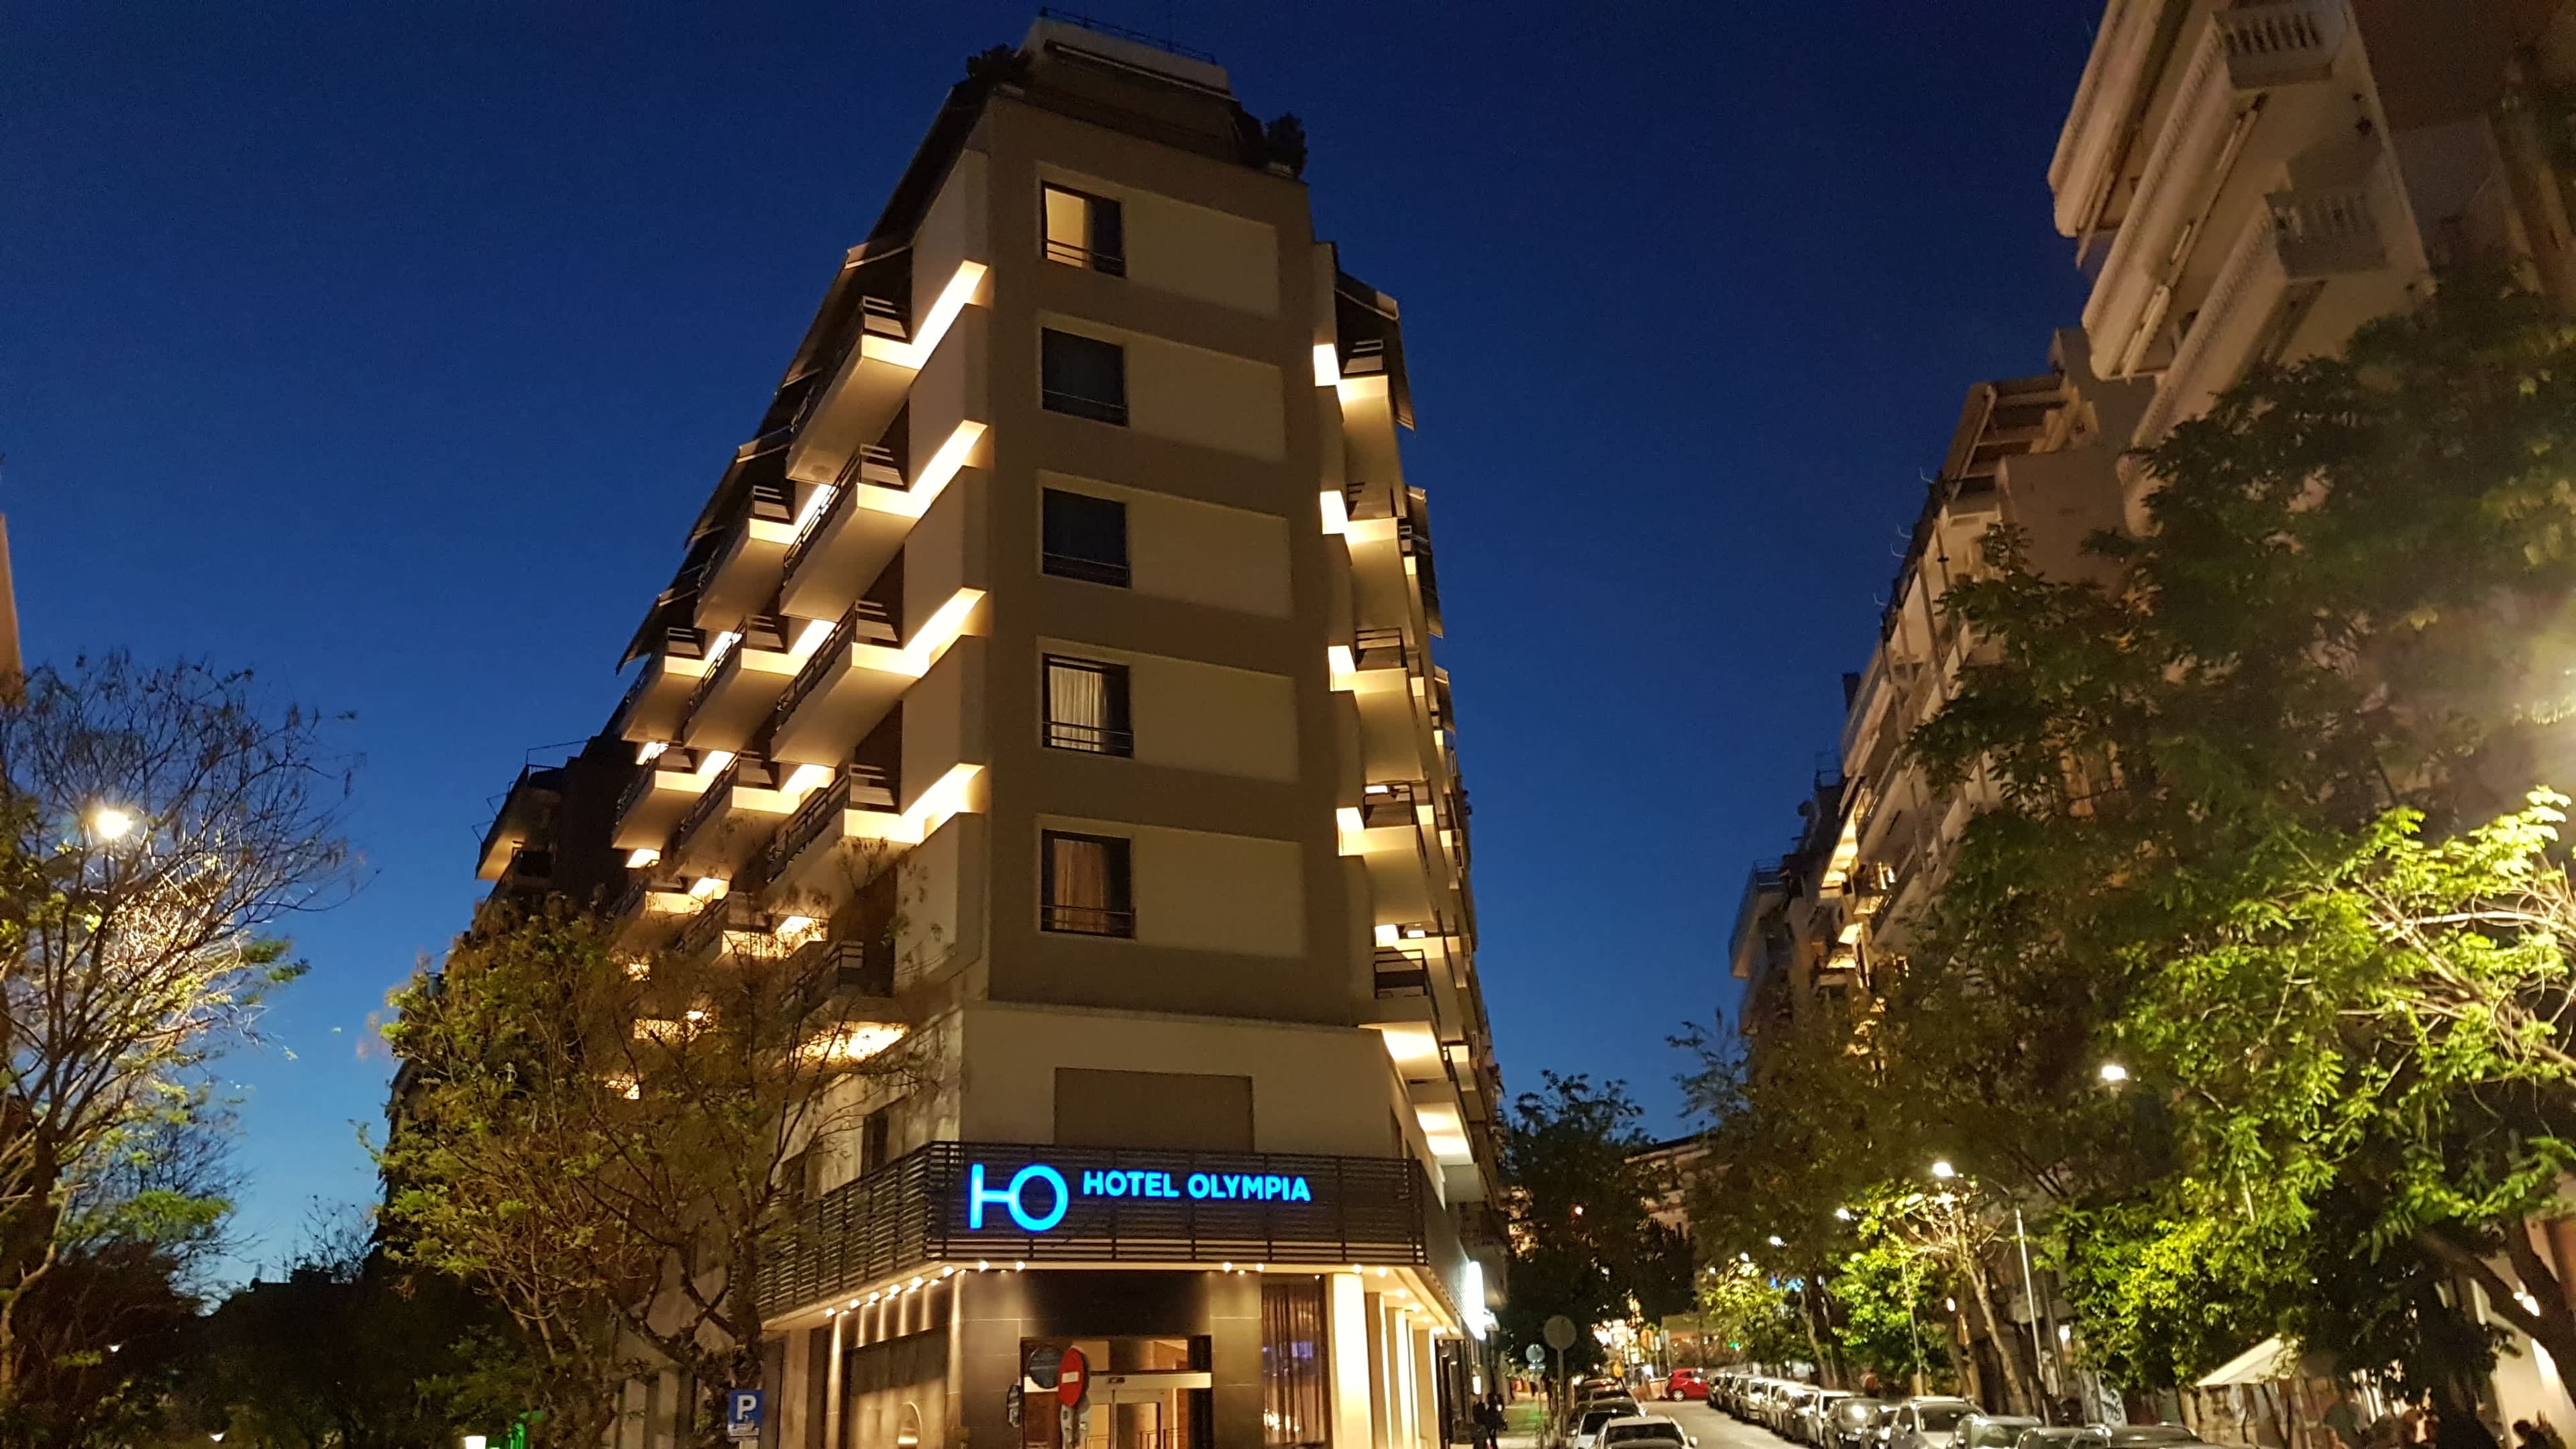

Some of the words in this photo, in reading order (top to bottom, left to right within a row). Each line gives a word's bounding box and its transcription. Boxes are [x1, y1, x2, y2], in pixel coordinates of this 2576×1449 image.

[1083, 1170, 1180, 1199] HOTEL
[1187, 1173, 1311, 1202] OLYMPIA
[737, 1395, 757, 1420] P
